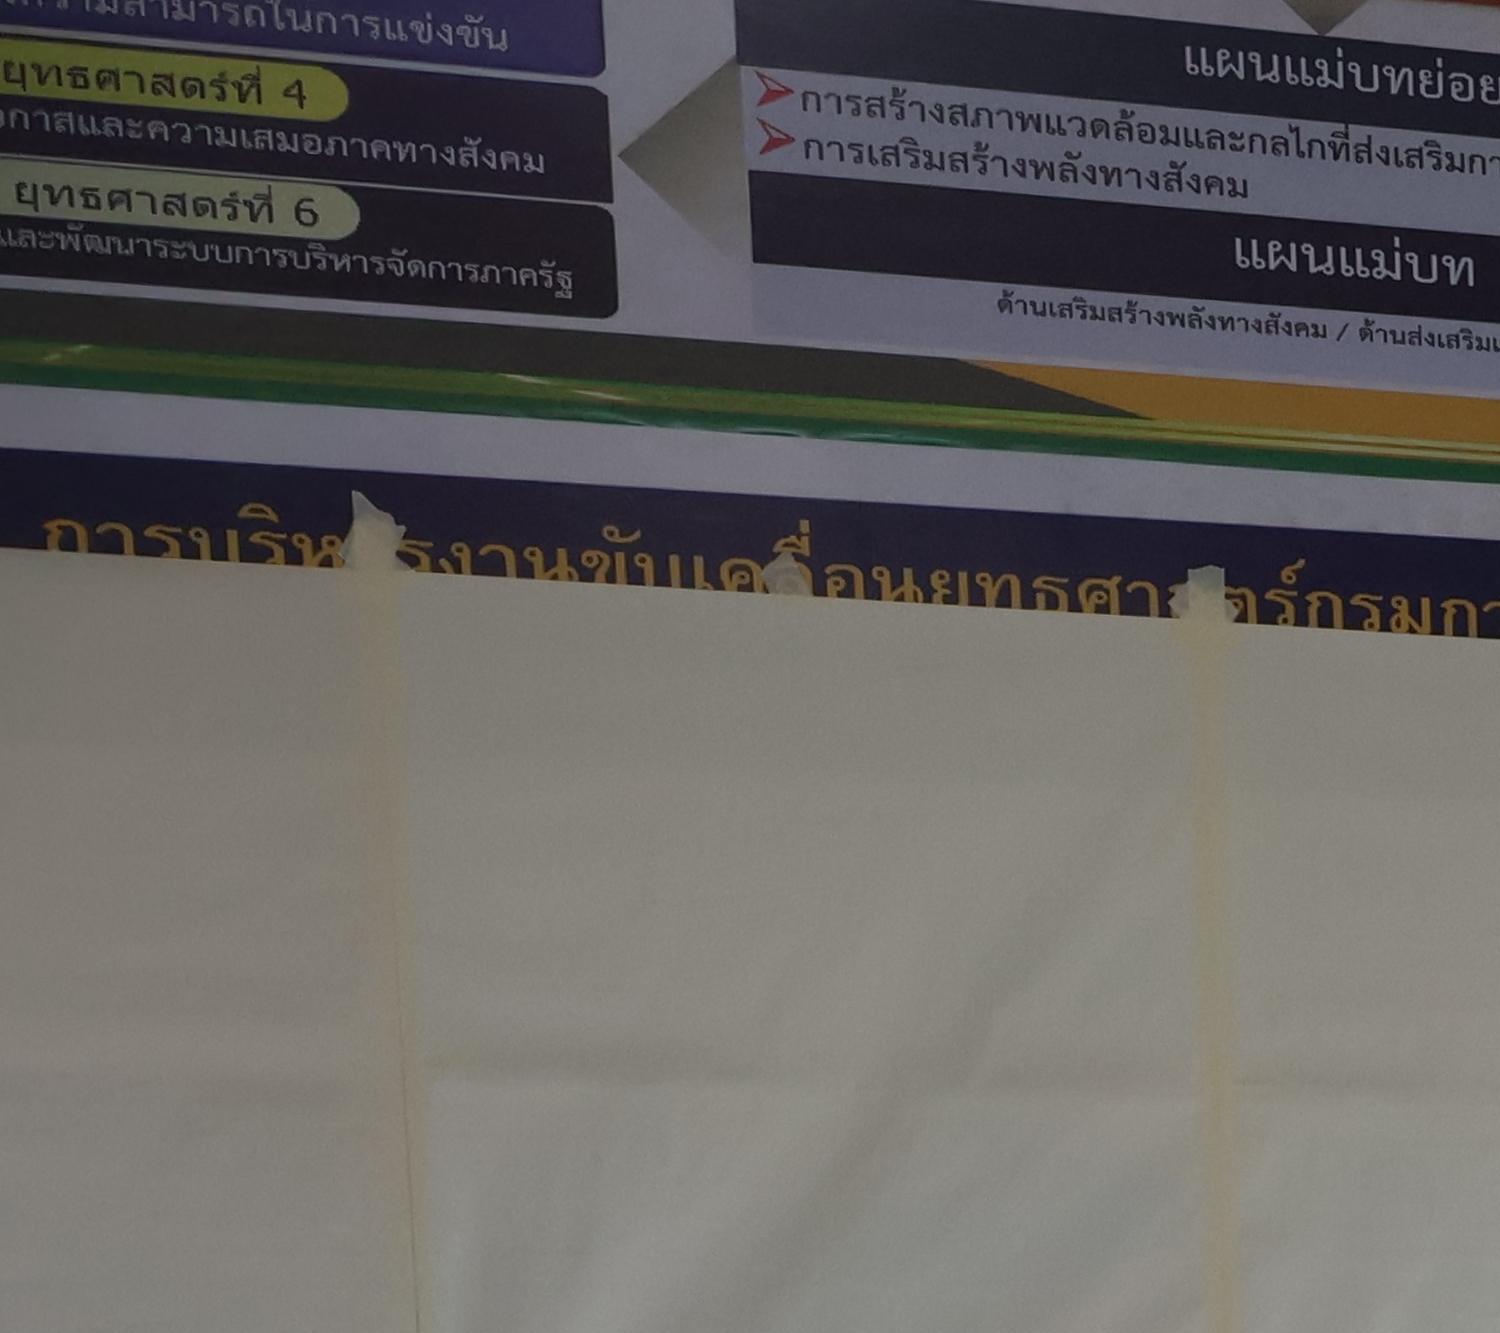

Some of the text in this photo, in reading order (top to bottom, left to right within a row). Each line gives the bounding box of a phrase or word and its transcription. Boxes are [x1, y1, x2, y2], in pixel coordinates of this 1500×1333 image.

[3, 58, 307, 109] ยุทธศาสตร์ที่ 4
[802, 134, 1249, 201] การเสริมสร้างพลังทางสังคม
[15, 180, 320, 228] ยุทธศาสตร์ที่ 6
[1233, 234, 1476, 288] แผนแม่บท
